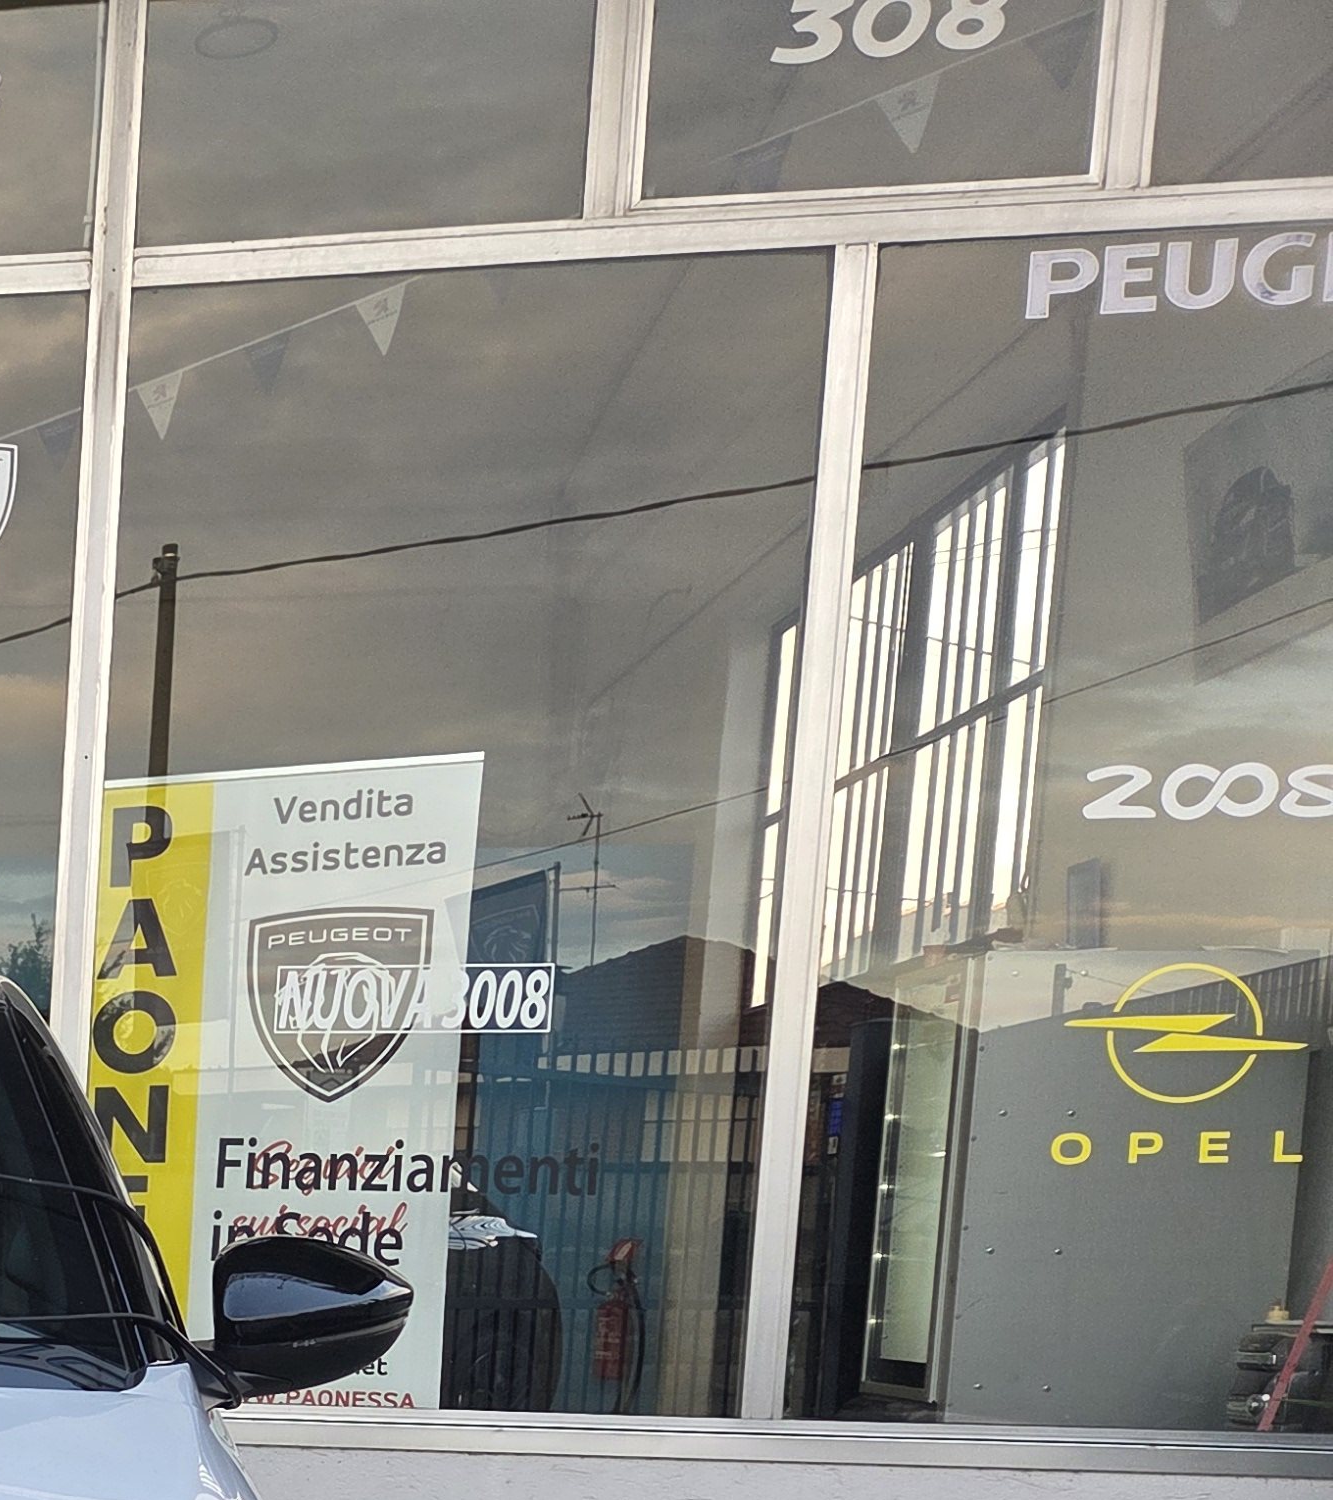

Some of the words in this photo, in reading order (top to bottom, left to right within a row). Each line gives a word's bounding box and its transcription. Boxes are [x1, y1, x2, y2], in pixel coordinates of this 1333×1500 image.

[769, 0, 1010, 64] 308
[1024, 231, 1333, 319] PEUG
[273, 789, 414, 825] Vendita
[1081, 761, 1333, 821] 2008
[244, 840, 447, 876] Assistenza
[267, 926, 413, 951] PEUGEOT
[278, 968, 433, 1030] NUOVA
[215, 1136, 600, 1197] Finanziamenti
[1050, 1130, 1304, 1166] OPEL
